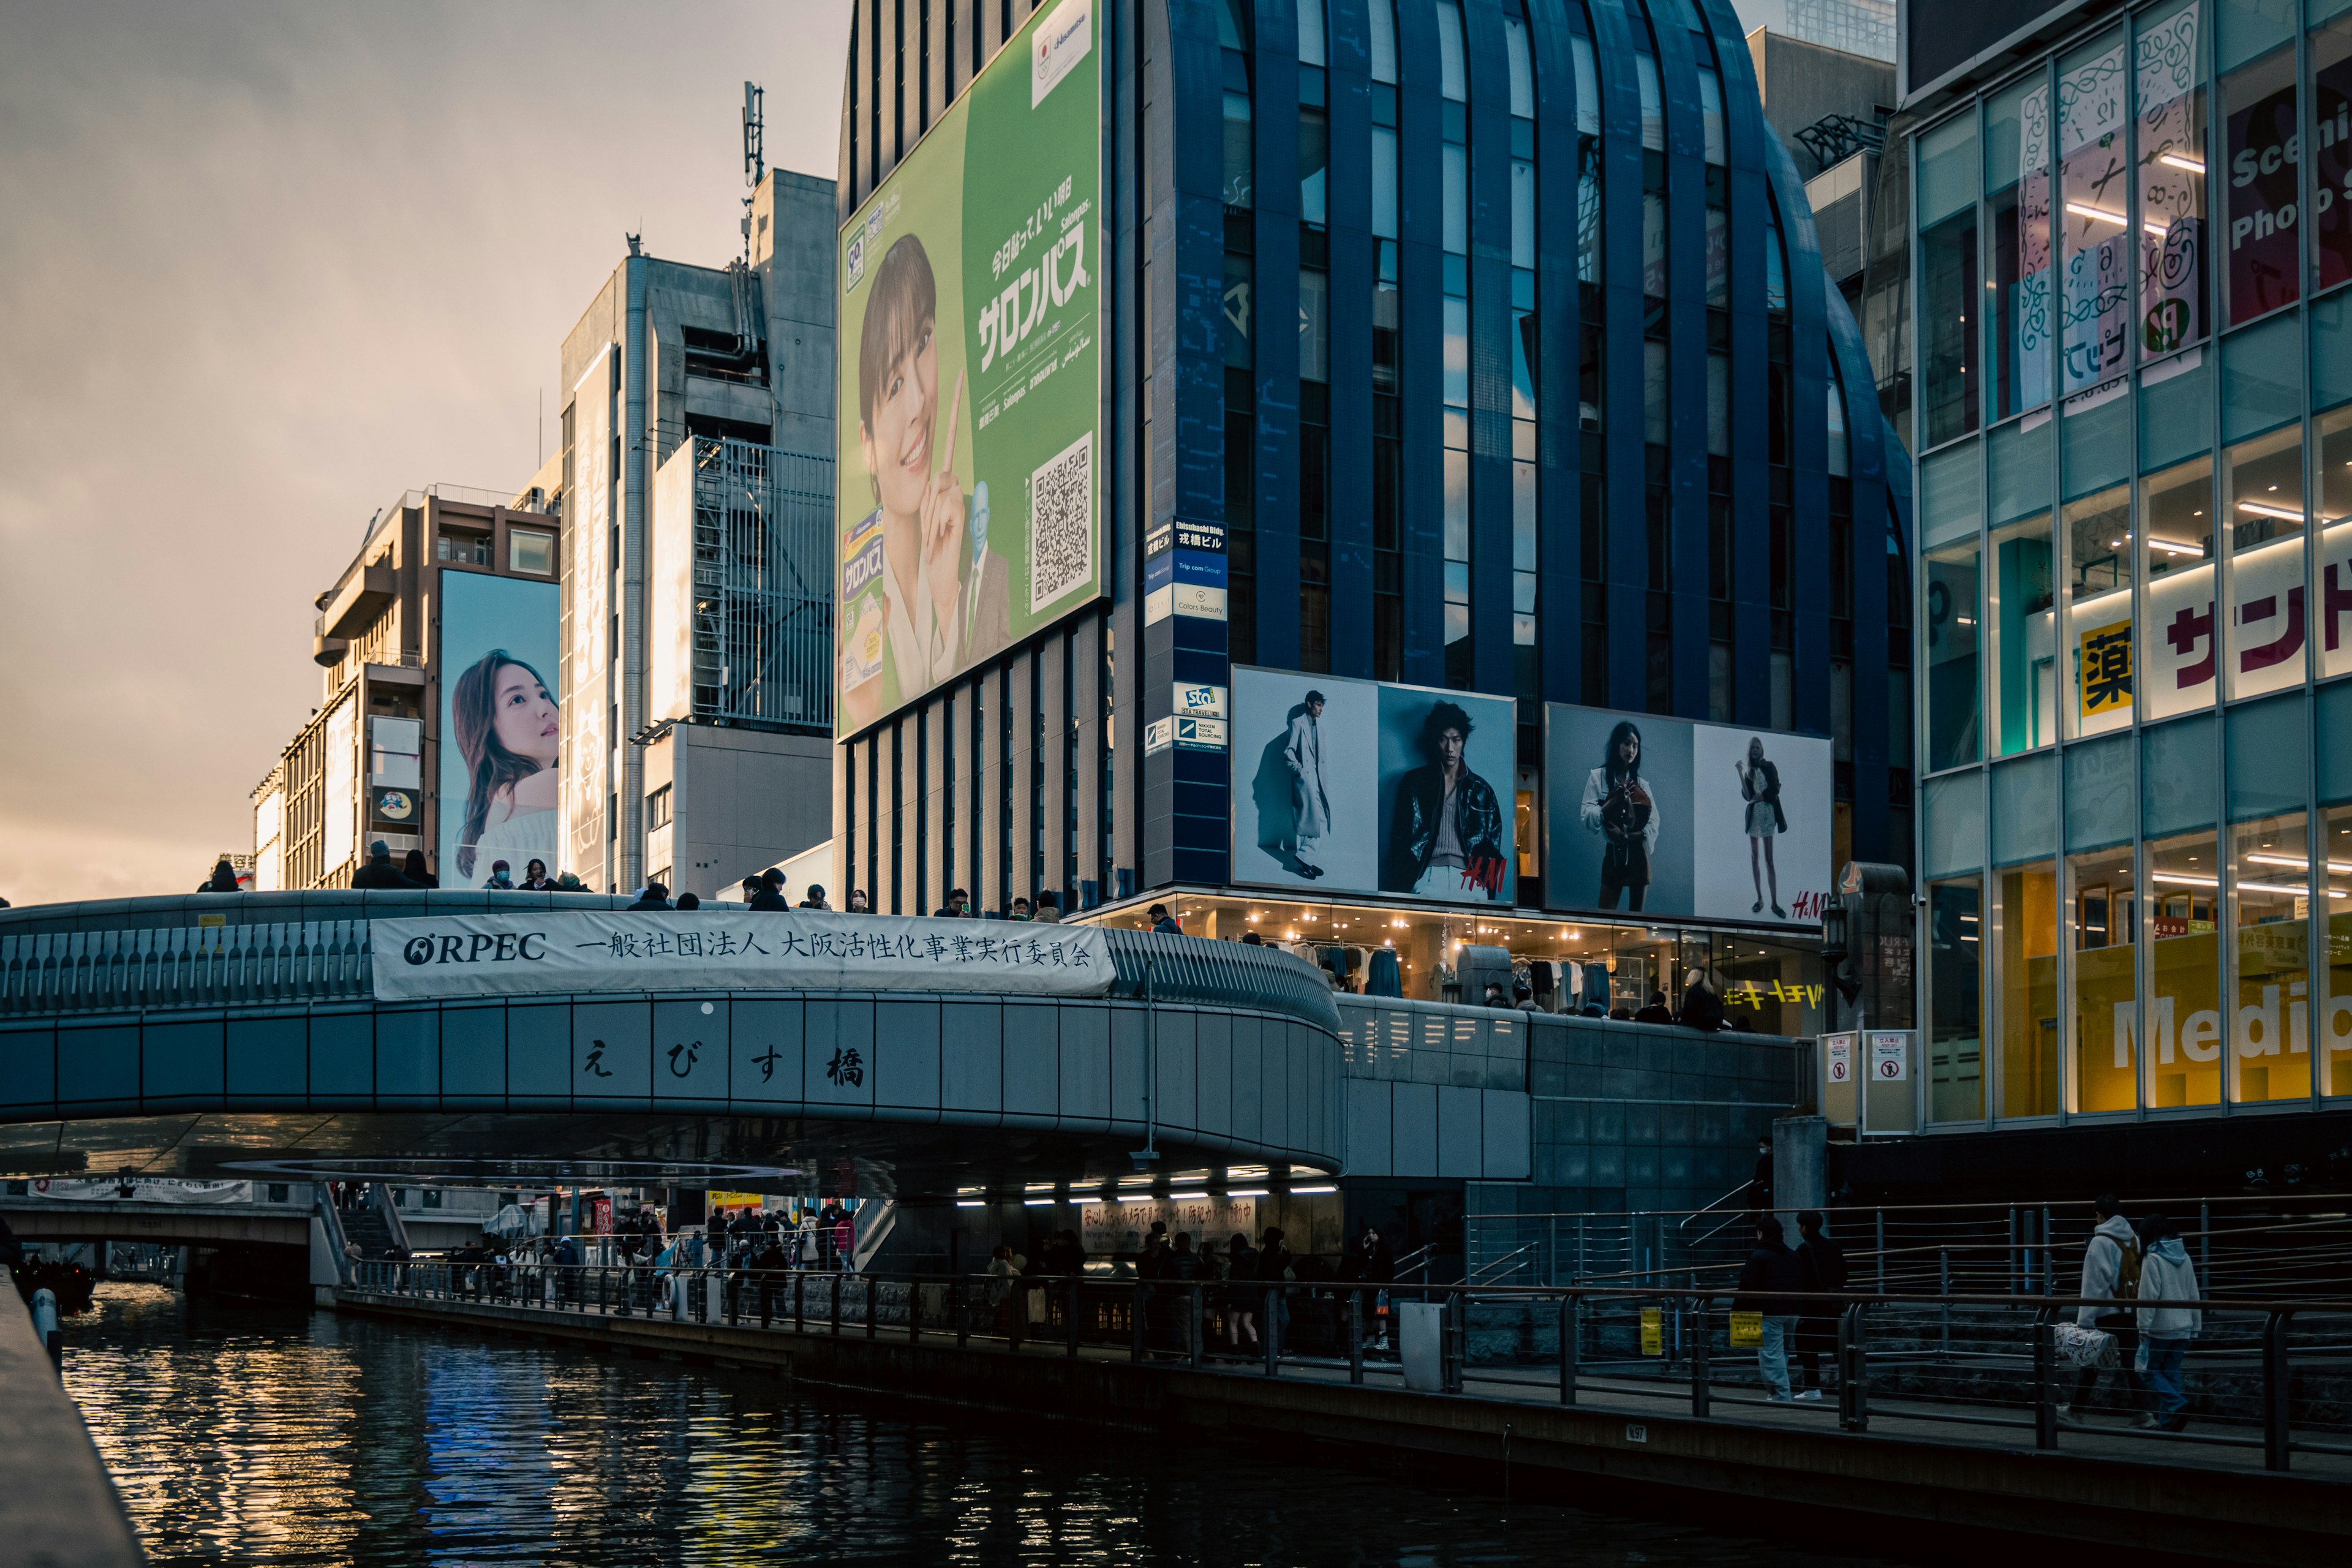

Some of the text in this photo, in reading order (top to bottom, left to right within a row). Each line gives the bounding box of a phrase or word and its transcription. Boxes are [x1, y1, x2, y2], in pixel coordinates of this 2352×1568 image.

[1054, 13, 1085, 50] Hisamitsu
[2231, 101, 2352, 188] Sceni
[992, 175, 1072, 282] 今日貼って、いい明日
[1060, 198, 1089, 234] Salonpas
[2232, 187, 2334, 251] Phoo
[978, 220, 1087, 374] サロンパス
[1003, 385, 1026, 412] Salonpas
[1176, 521, 1224, 537] Ebisubashi Bldg.
[1179, 532, 1222, 549] 戎橋ビル
[846, 545, 881, 594] サロンパス
[1204, 566, 1221, 575] Group
[1178, 602, 1223, 615] Colors Beauty
[2086, 624, 2135, 710] 薬
[1188, 689, 1211, 705] sta
[1460, 856, 1507, 895] H&M
[1792, 890, 1828, 921] H&M
[2163, 924, 2185, 933] お会計
[404, 930, 1091, 968] ORPEC 一般社団法人 大阪活性化事業実行委員会
[584, 1039, 864, 1088] えびす橋
